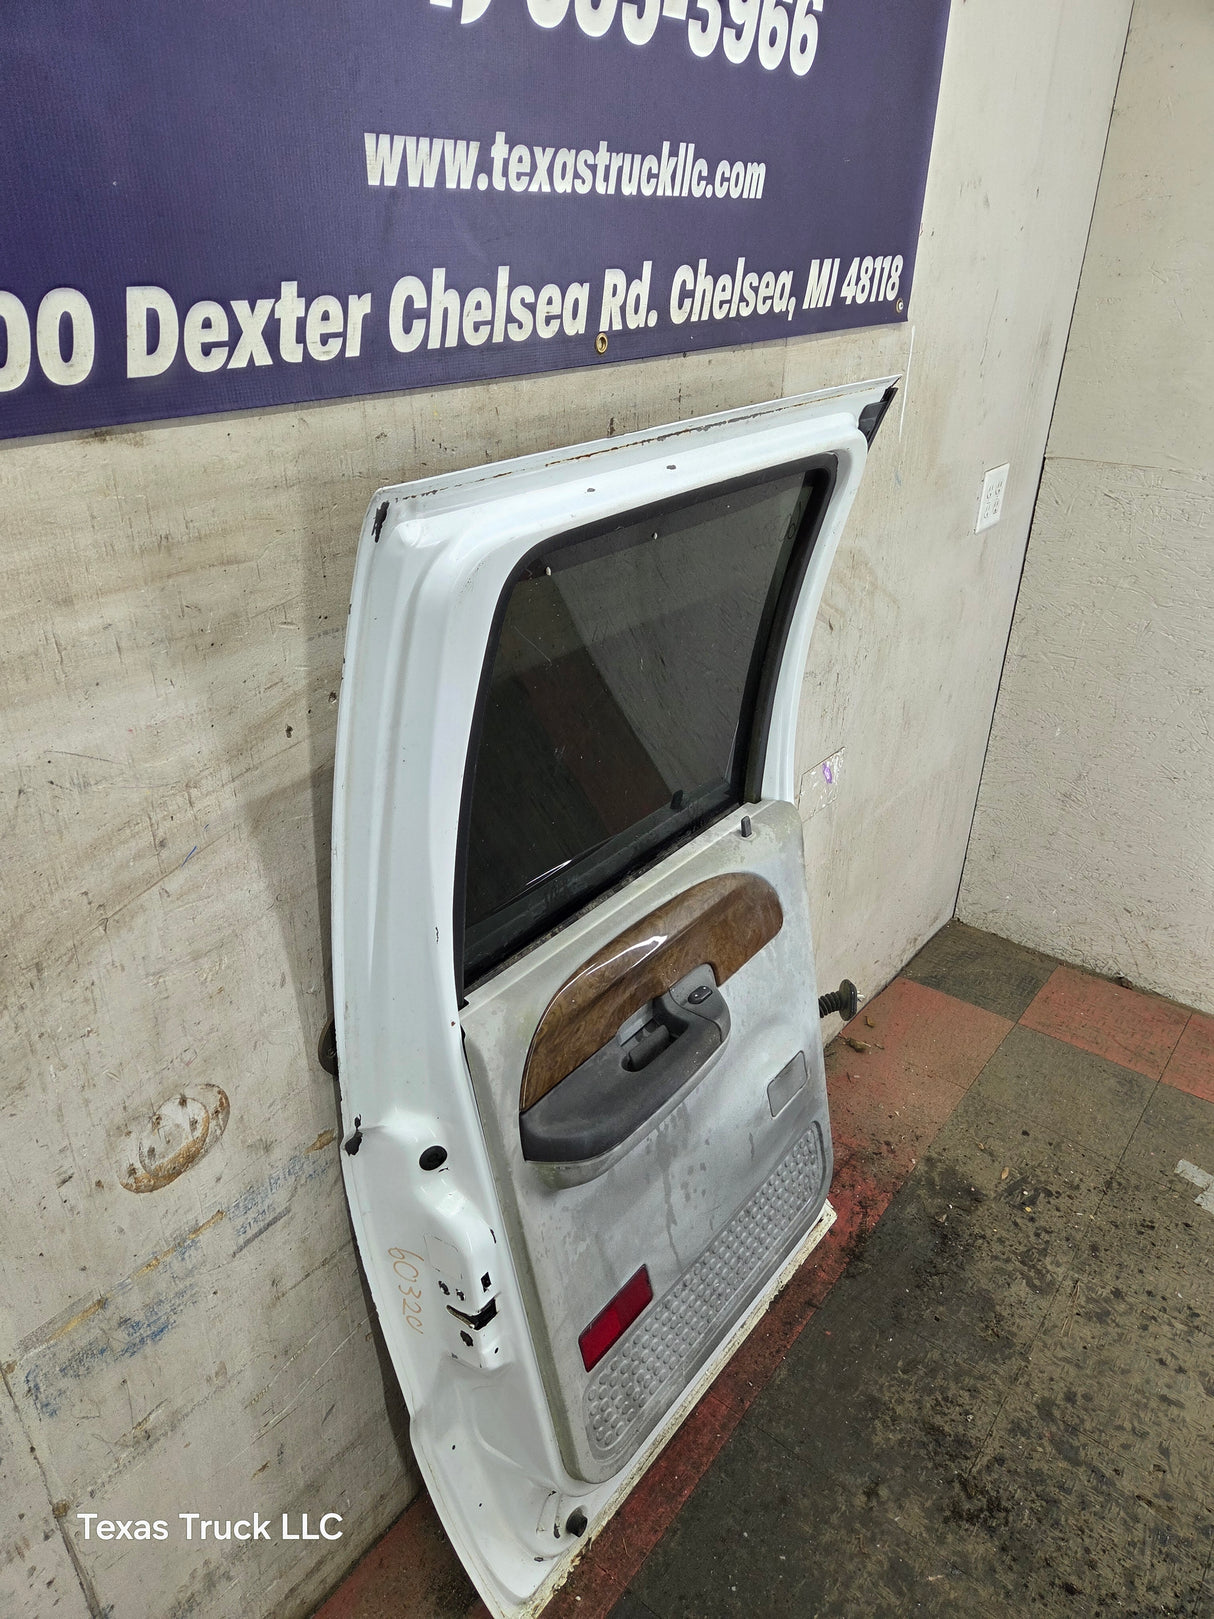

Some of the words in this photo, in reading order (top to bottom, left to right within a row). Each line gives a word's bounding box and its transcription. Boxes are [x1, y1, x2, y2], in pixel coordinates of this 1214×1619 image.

[364, 131, 766, 200] www.texastruckllc.com
[125, 280, 372, 379] Dexter
[388, 266, 590, 353] Chelsea
[598, 261, 658, 333] Rd.
[669, 256, 797, 322] Chelsea,
[802, 258, 841, 310] MI
[839, 254, 904, 305] 48118
